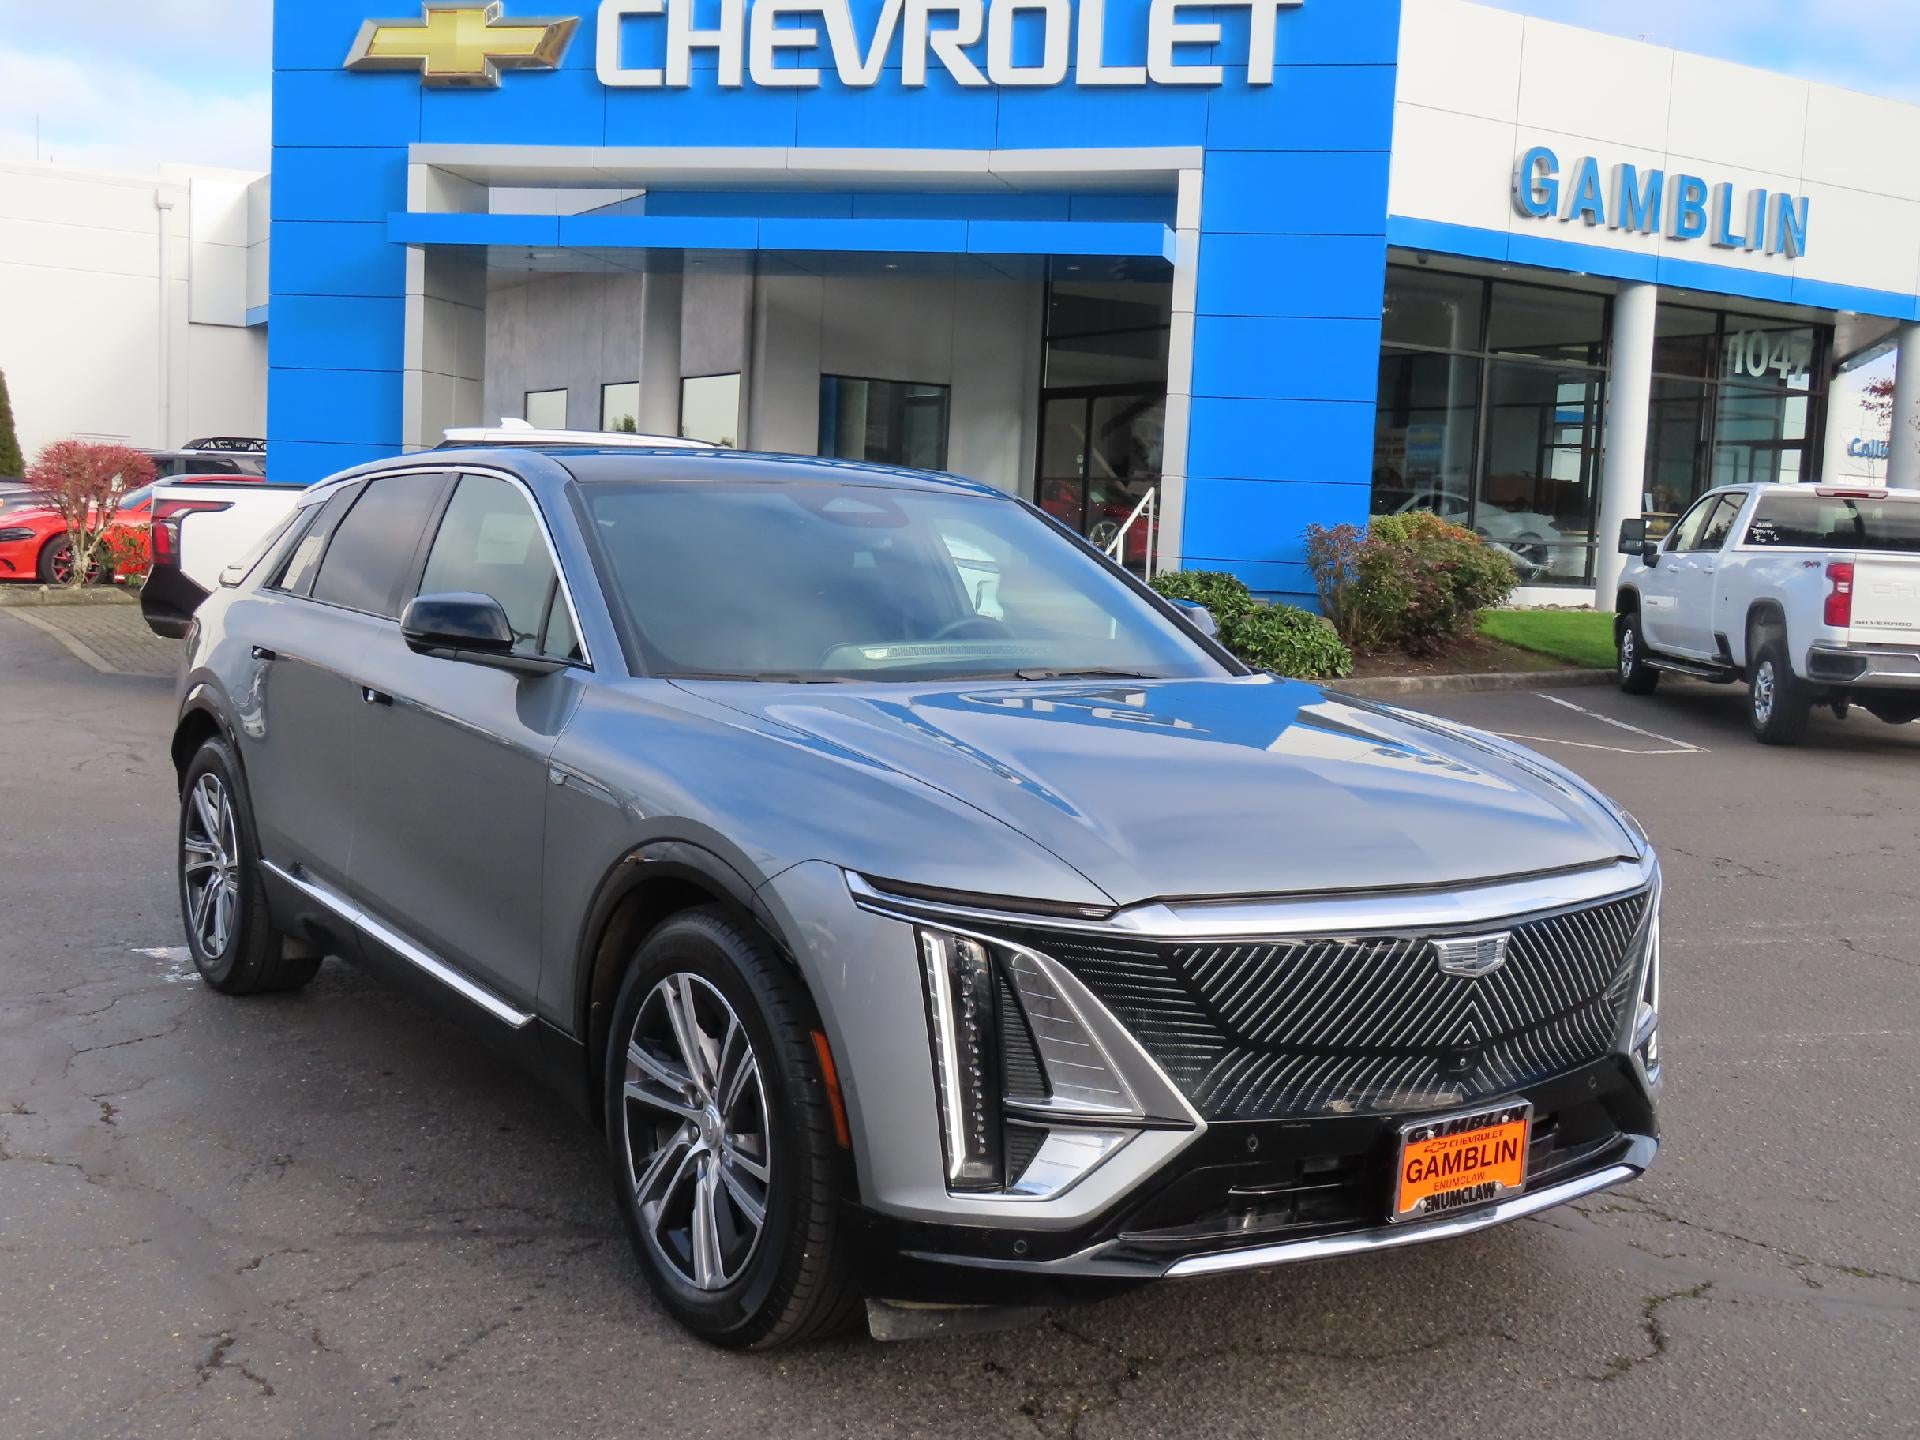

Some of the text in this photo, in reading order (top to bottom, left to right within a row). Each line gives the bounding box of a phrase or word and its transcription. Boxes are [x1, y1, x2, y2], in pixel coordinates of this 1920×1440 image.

[596, 0, 1304, 88] CHEVROLET
[1512, 146, 1810, 259] GAMBLIN
[1449, 1129, 1504, 1149] CHEVROLET
[1406, 1137, 1518, 1184] GAMBLIN
[1424, 1181, 1496, 1213] ENUMCLAW
[1433, 1171, 1486, 1191] ENUMCLAW
